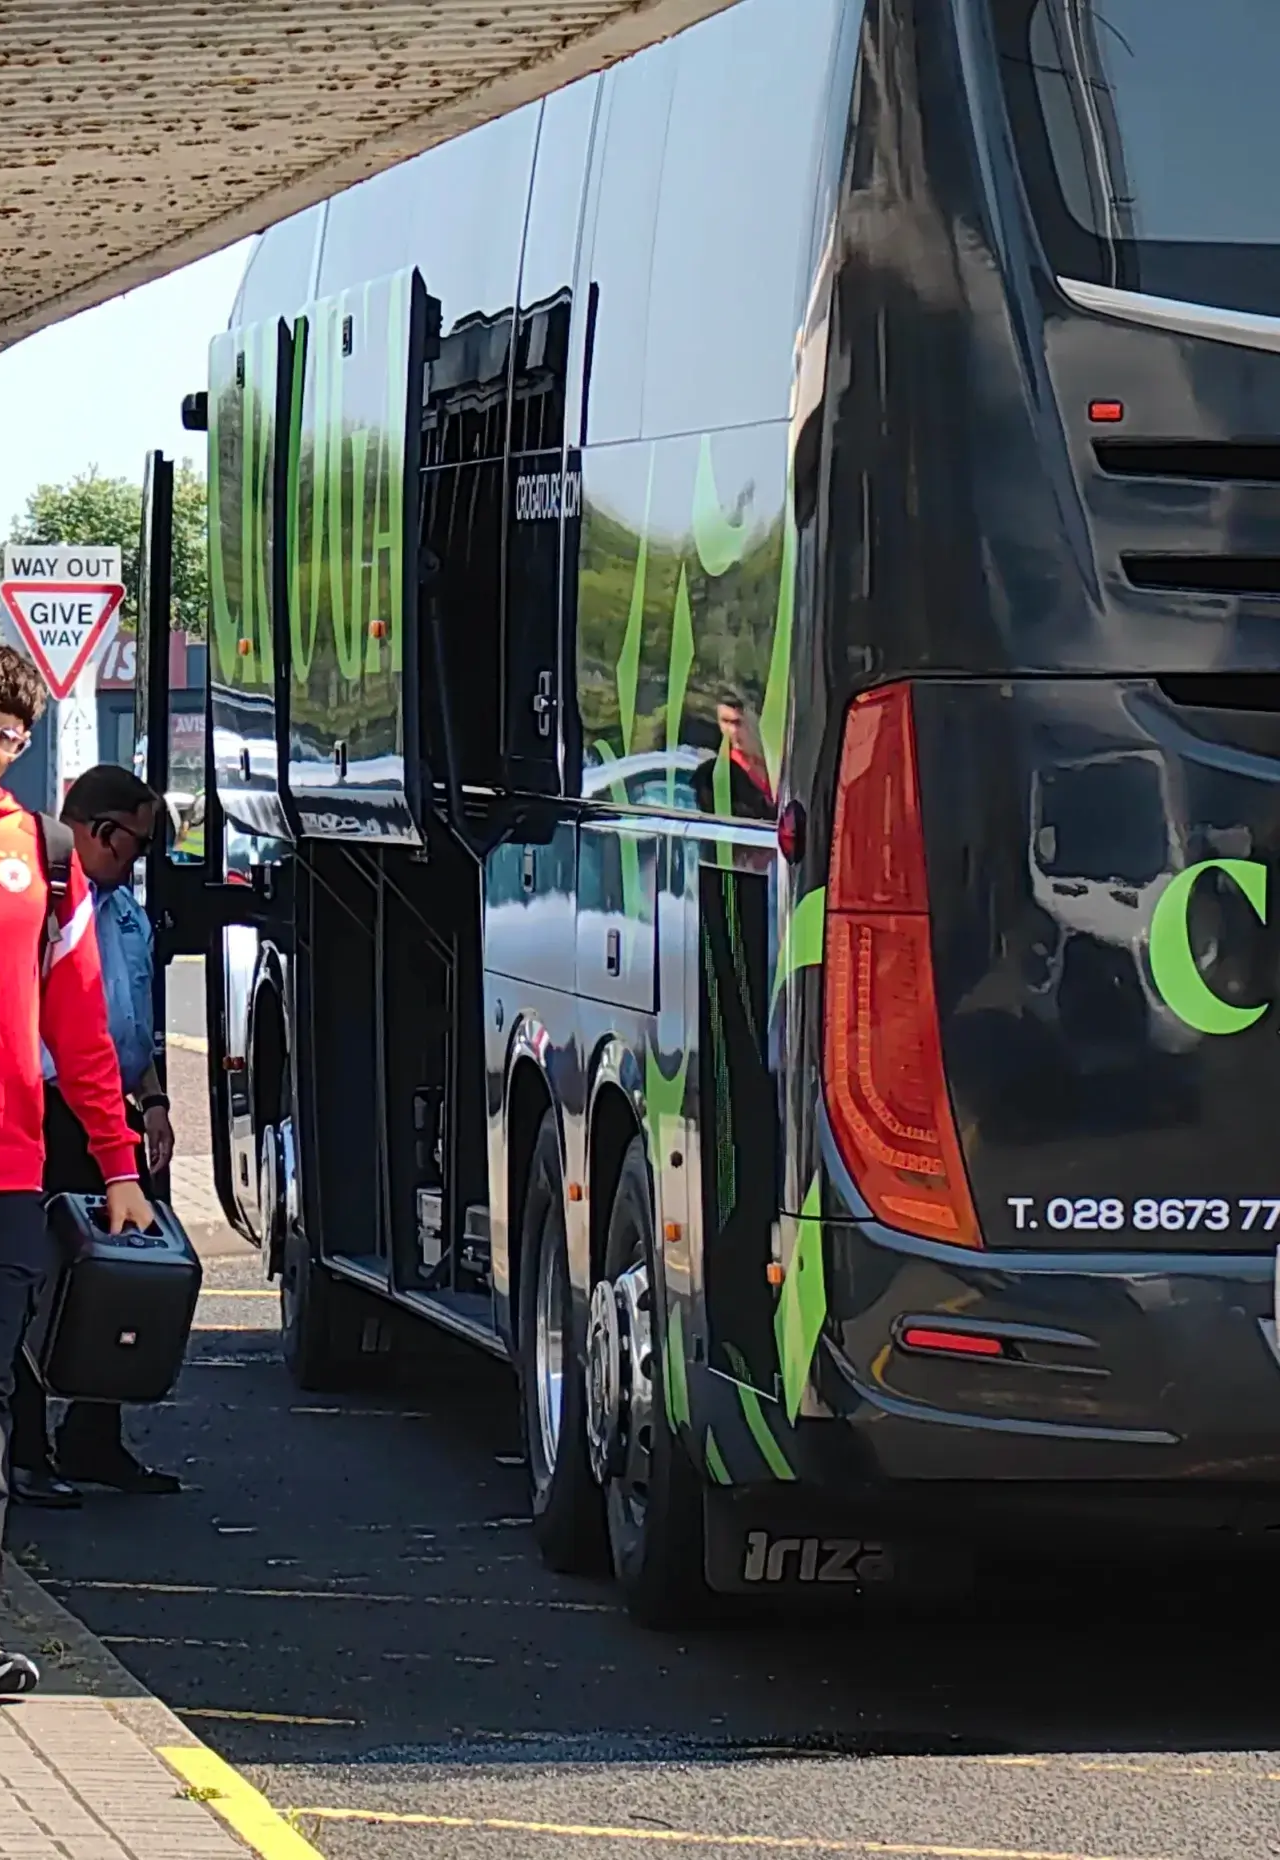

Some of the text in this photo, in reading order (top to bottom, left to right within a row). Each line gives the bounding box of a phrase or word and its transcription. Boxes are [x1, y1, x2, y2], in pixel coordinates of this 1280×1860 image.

[11, 557, 115, 578] WAY OUT
[30, 602, 94, 626] GIVE
[39, 630, 84, 647] WAY
[1007, 1197, 1280, 1231] T. 028 8673 77
